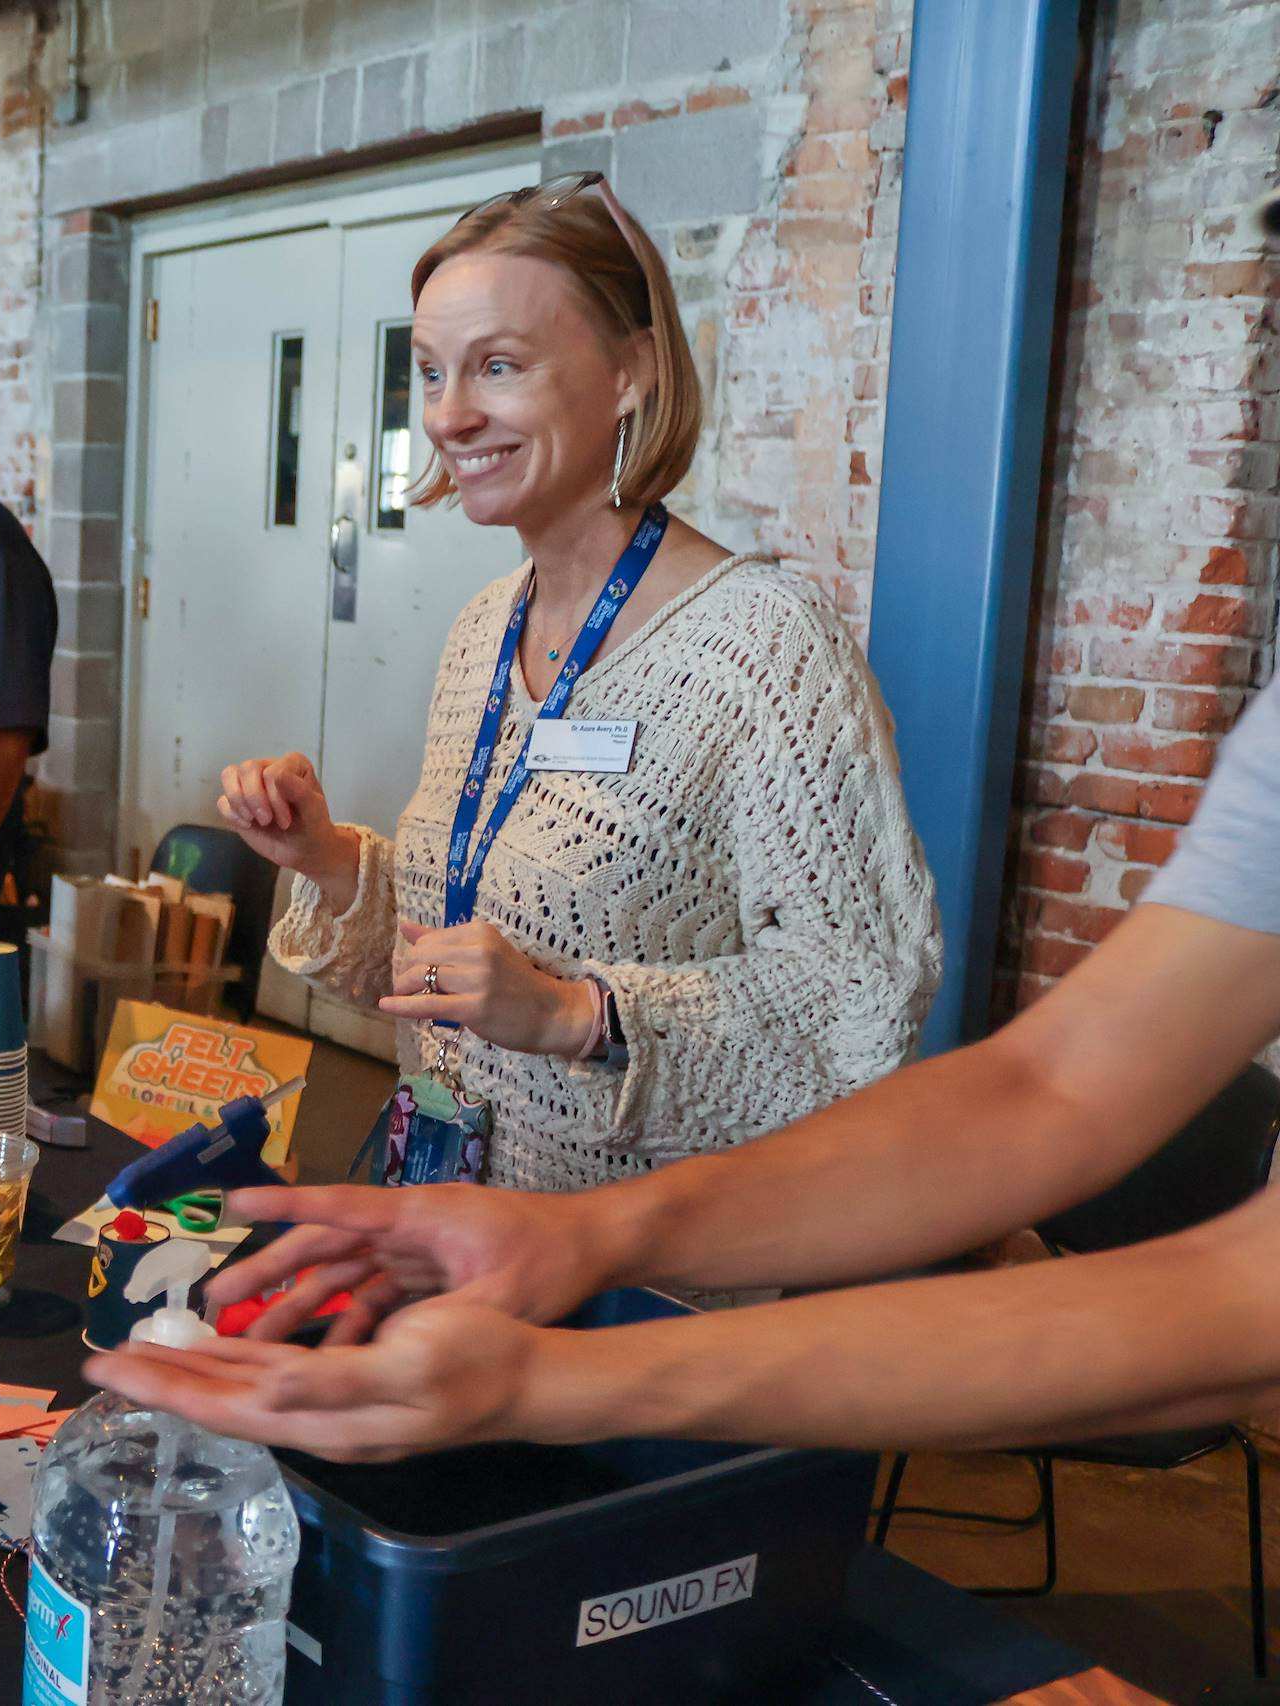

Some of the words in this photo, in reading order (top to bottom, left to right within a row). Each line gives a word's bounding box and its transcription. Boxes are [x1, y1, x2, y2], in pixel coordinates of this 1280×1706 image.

[163, 1024, 255, 1068] FELT
[130, 1050, 268, 1099] SHEETS
[585, 1578, 704, 1637] SOUND
[713, 1564, 751, 1601] FX
